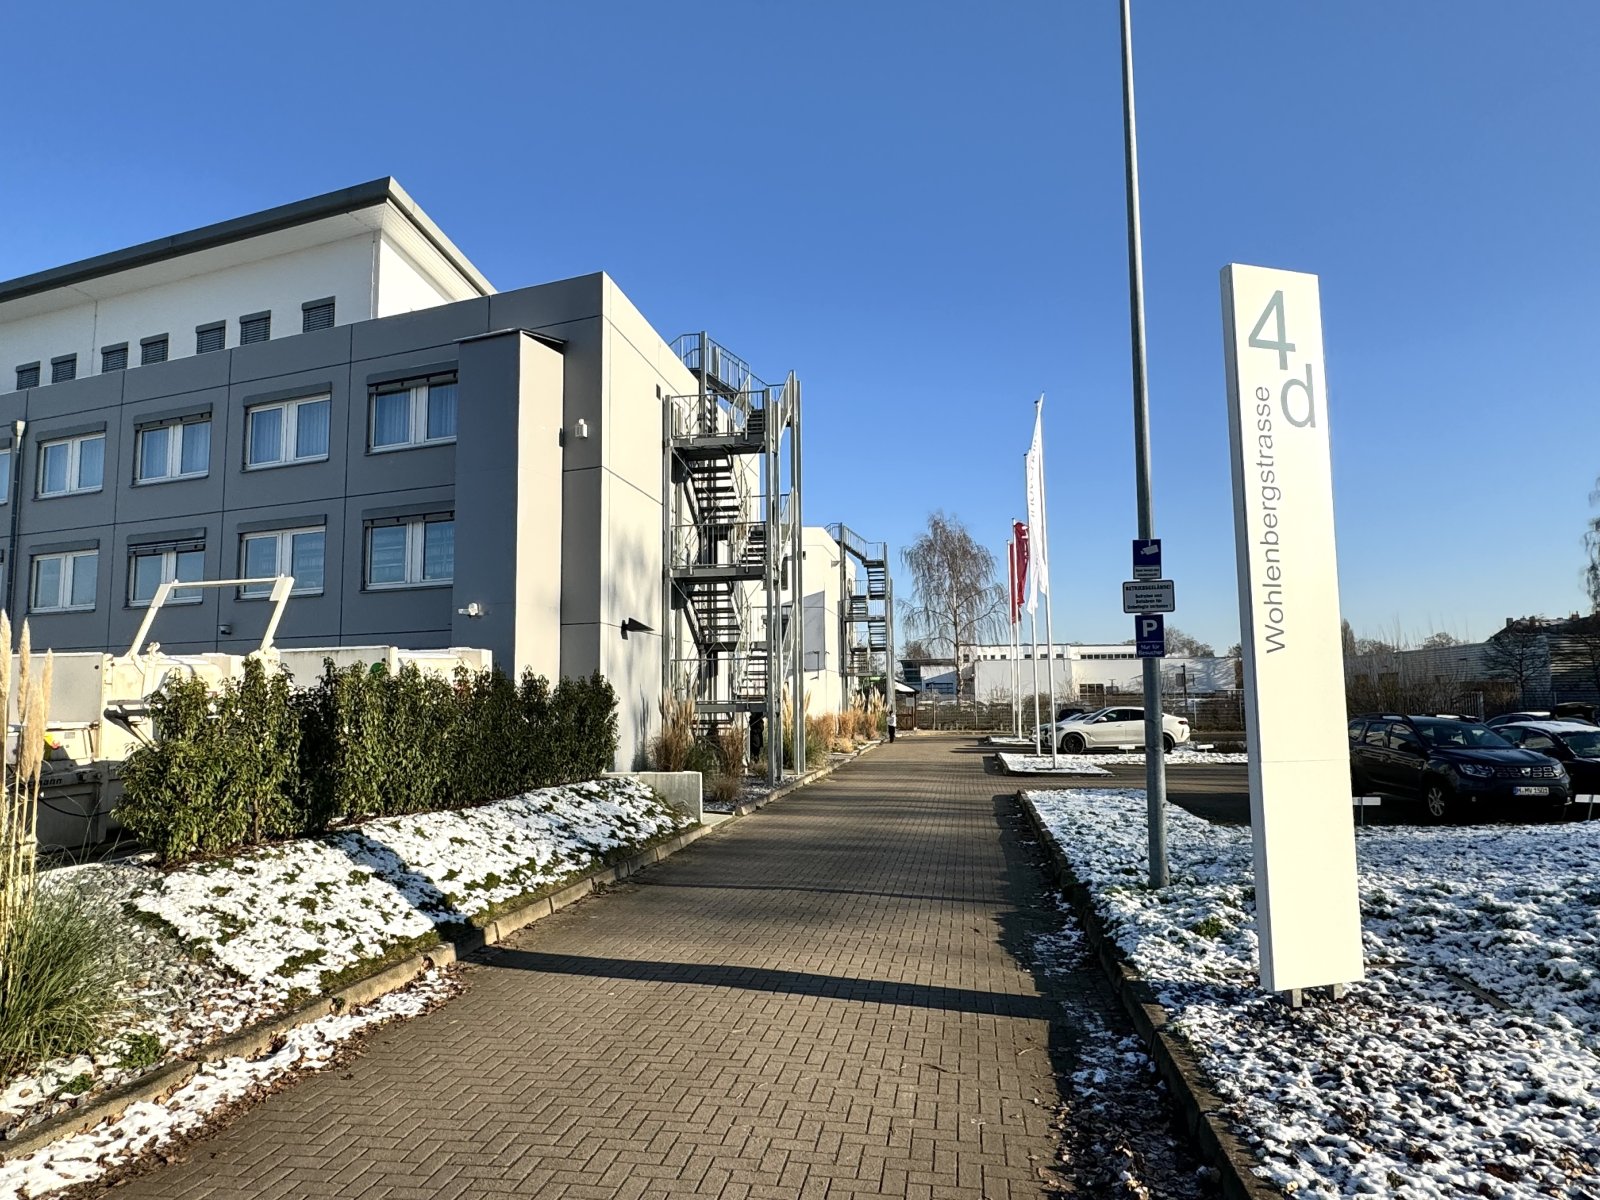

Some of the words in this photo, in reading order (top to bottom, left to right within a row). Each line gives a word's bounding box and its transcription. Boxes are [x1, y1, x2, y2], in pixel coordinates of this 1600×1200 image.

[1248, 289, 1296, 371] 4
[1280, 363, 1316, 428] d
[1255, 386, 1286, 654] Wohlenbergstrasse
[1142, 619, 1158, 638] P
